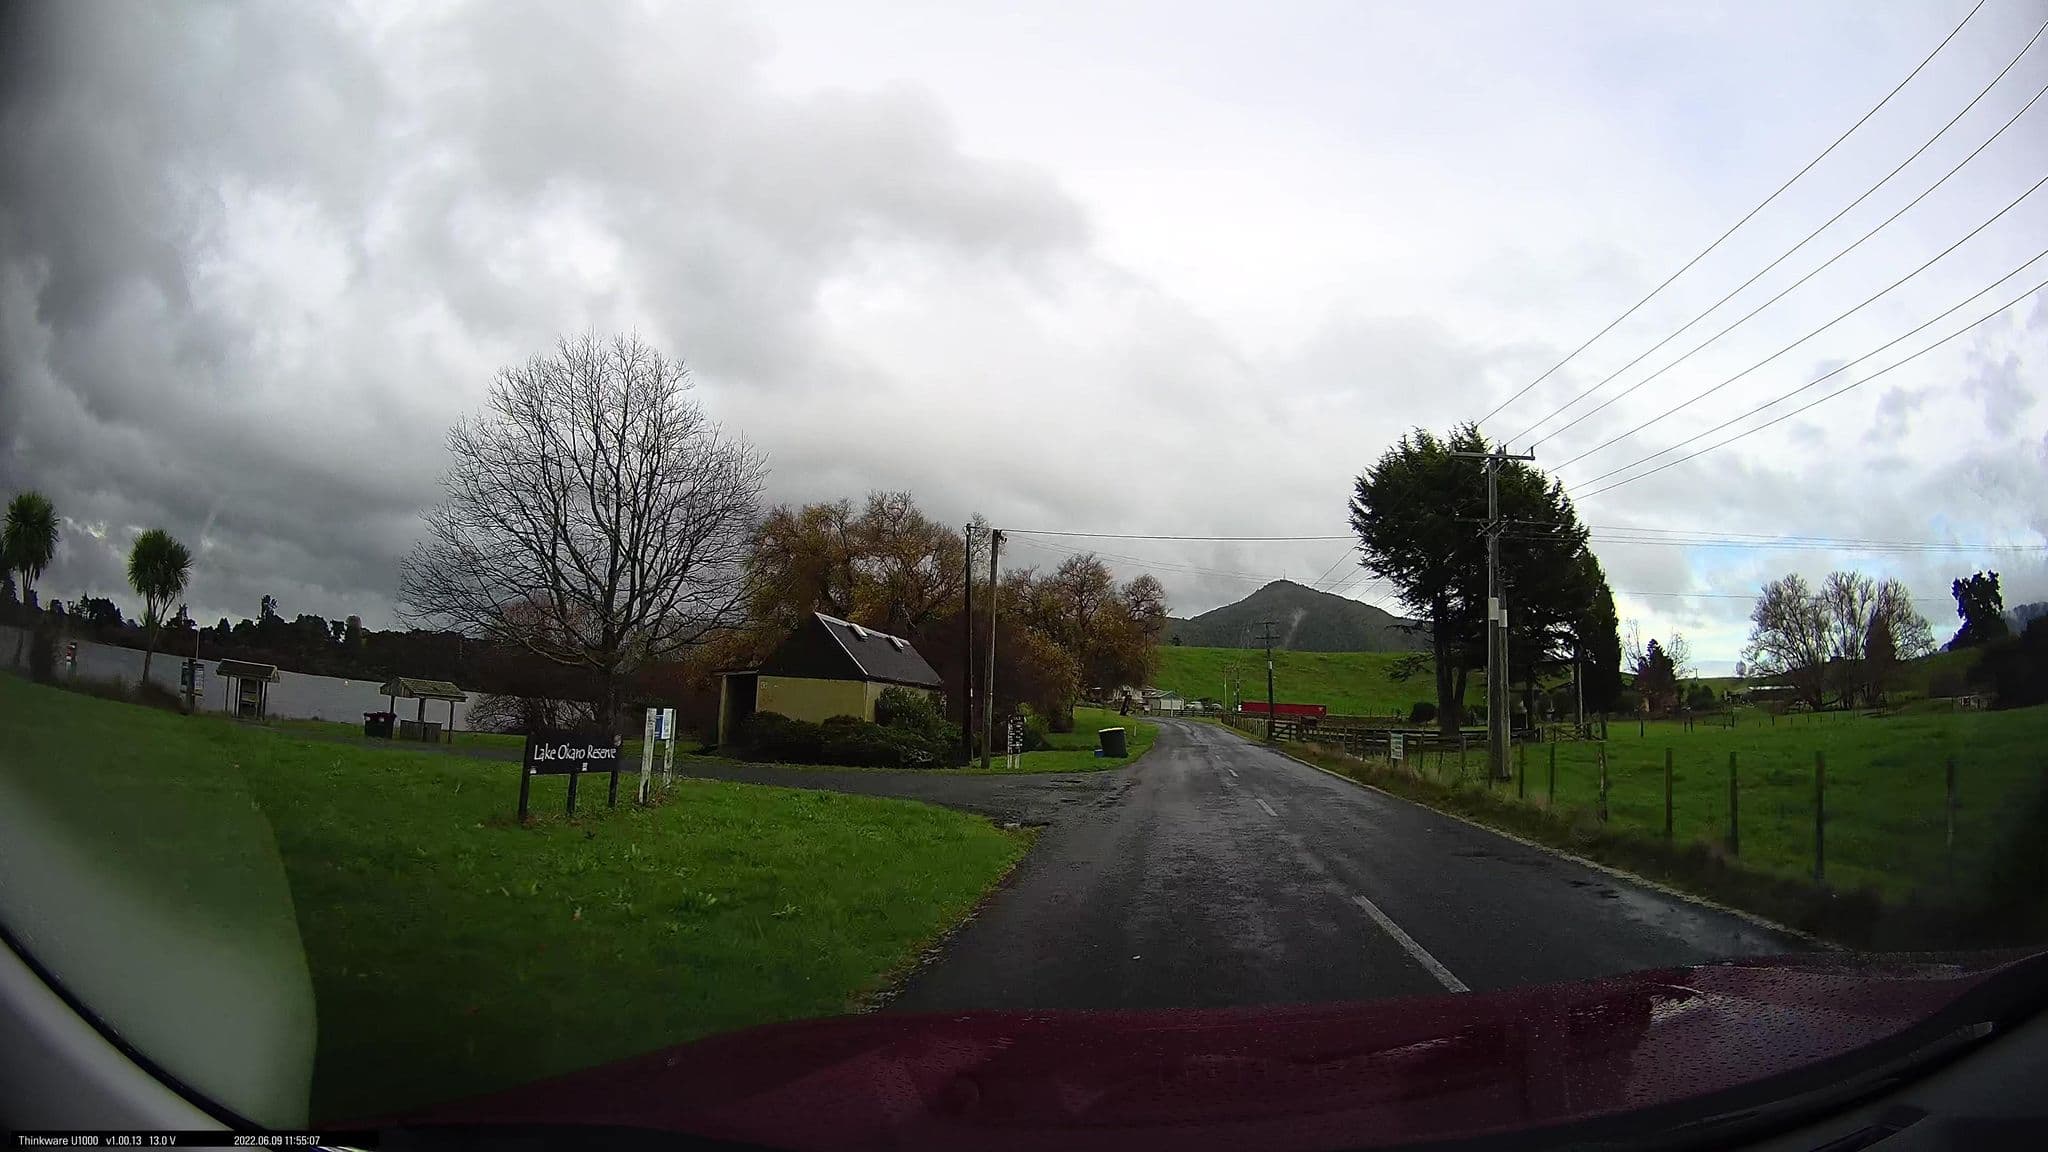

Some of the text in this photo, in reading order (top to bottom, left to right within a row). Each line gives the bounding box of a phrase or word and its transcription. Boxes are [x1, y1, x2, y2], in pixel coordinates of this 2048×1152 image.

[534, 743, 617, 761] Lake Okaro Reserve
